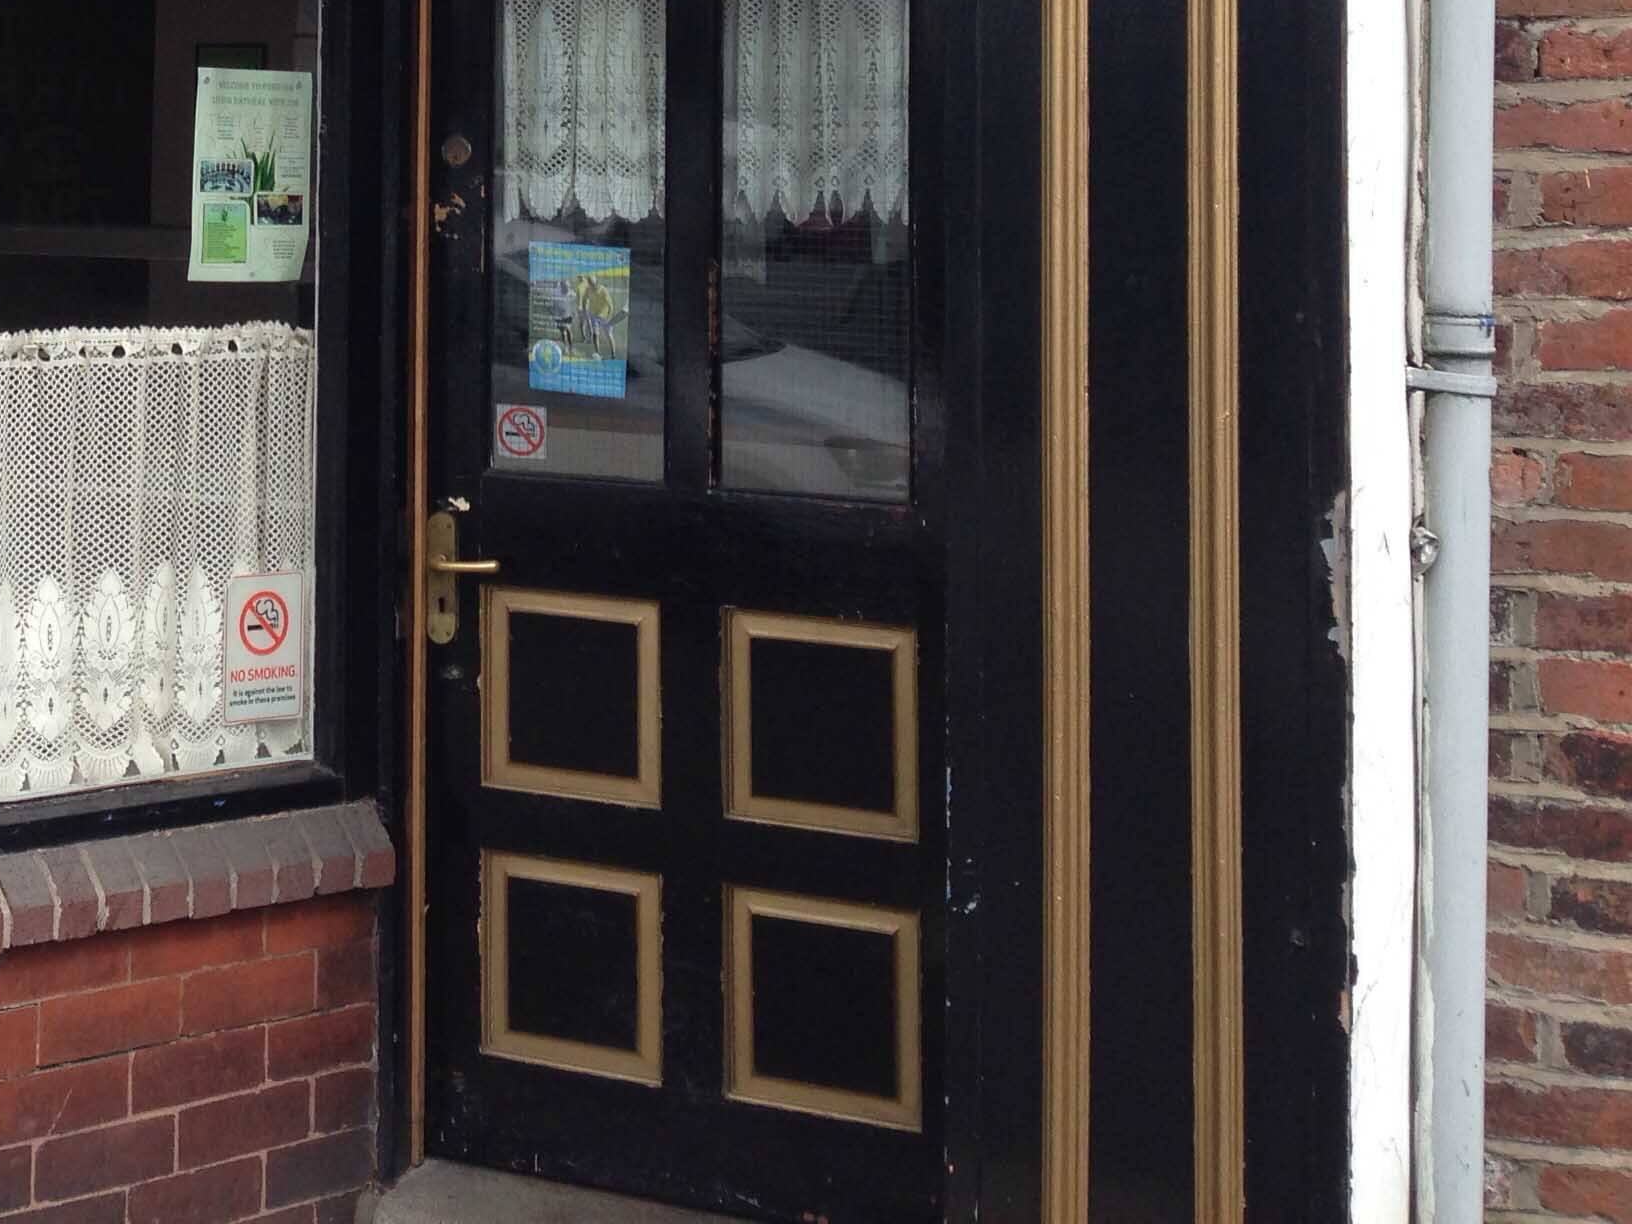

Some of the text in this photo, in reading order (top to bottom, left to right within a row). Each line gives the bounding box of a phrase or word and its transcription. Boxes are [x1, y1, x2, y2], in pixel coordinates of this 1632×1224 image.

[230, 665, 296, 683] NO SMOKING
[245, 687, 265, 698] against
[266, 686, 275, 694] the
[230, 698, 247, 706] smoke
[271, 694, 296, 704] premises
